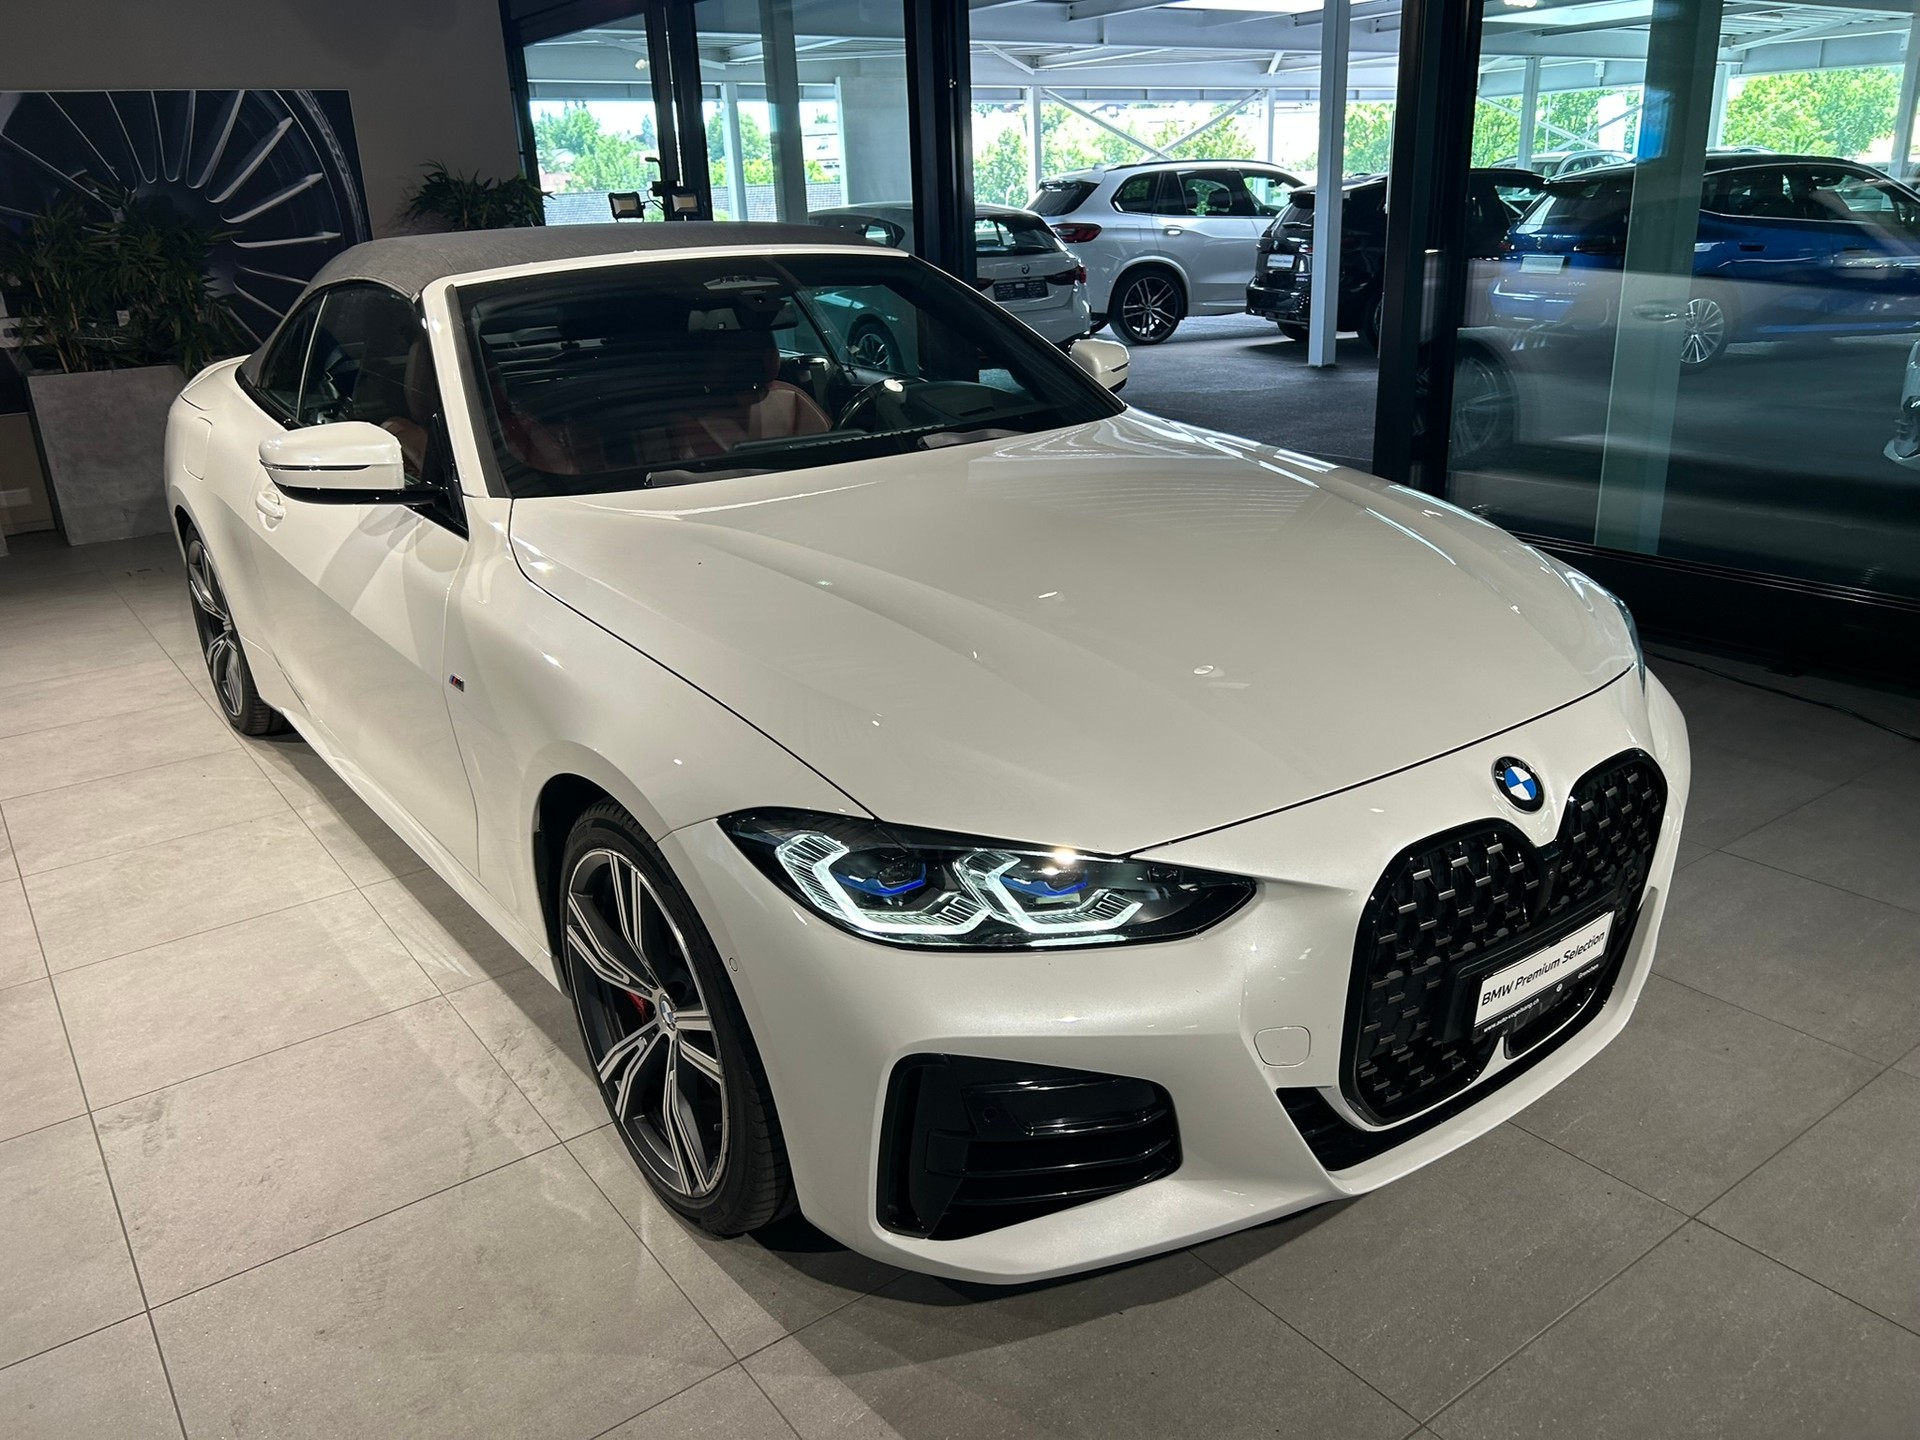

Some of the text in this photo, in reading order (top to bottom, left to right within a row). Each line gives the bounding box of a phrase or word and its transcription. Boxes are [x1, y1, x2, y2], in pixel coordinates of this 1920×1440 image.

[1481, 980, 1514, 1006] BMW
[1515, 958, 1560, 990] Premium
[1562, 932, 1605, 964] Selection
